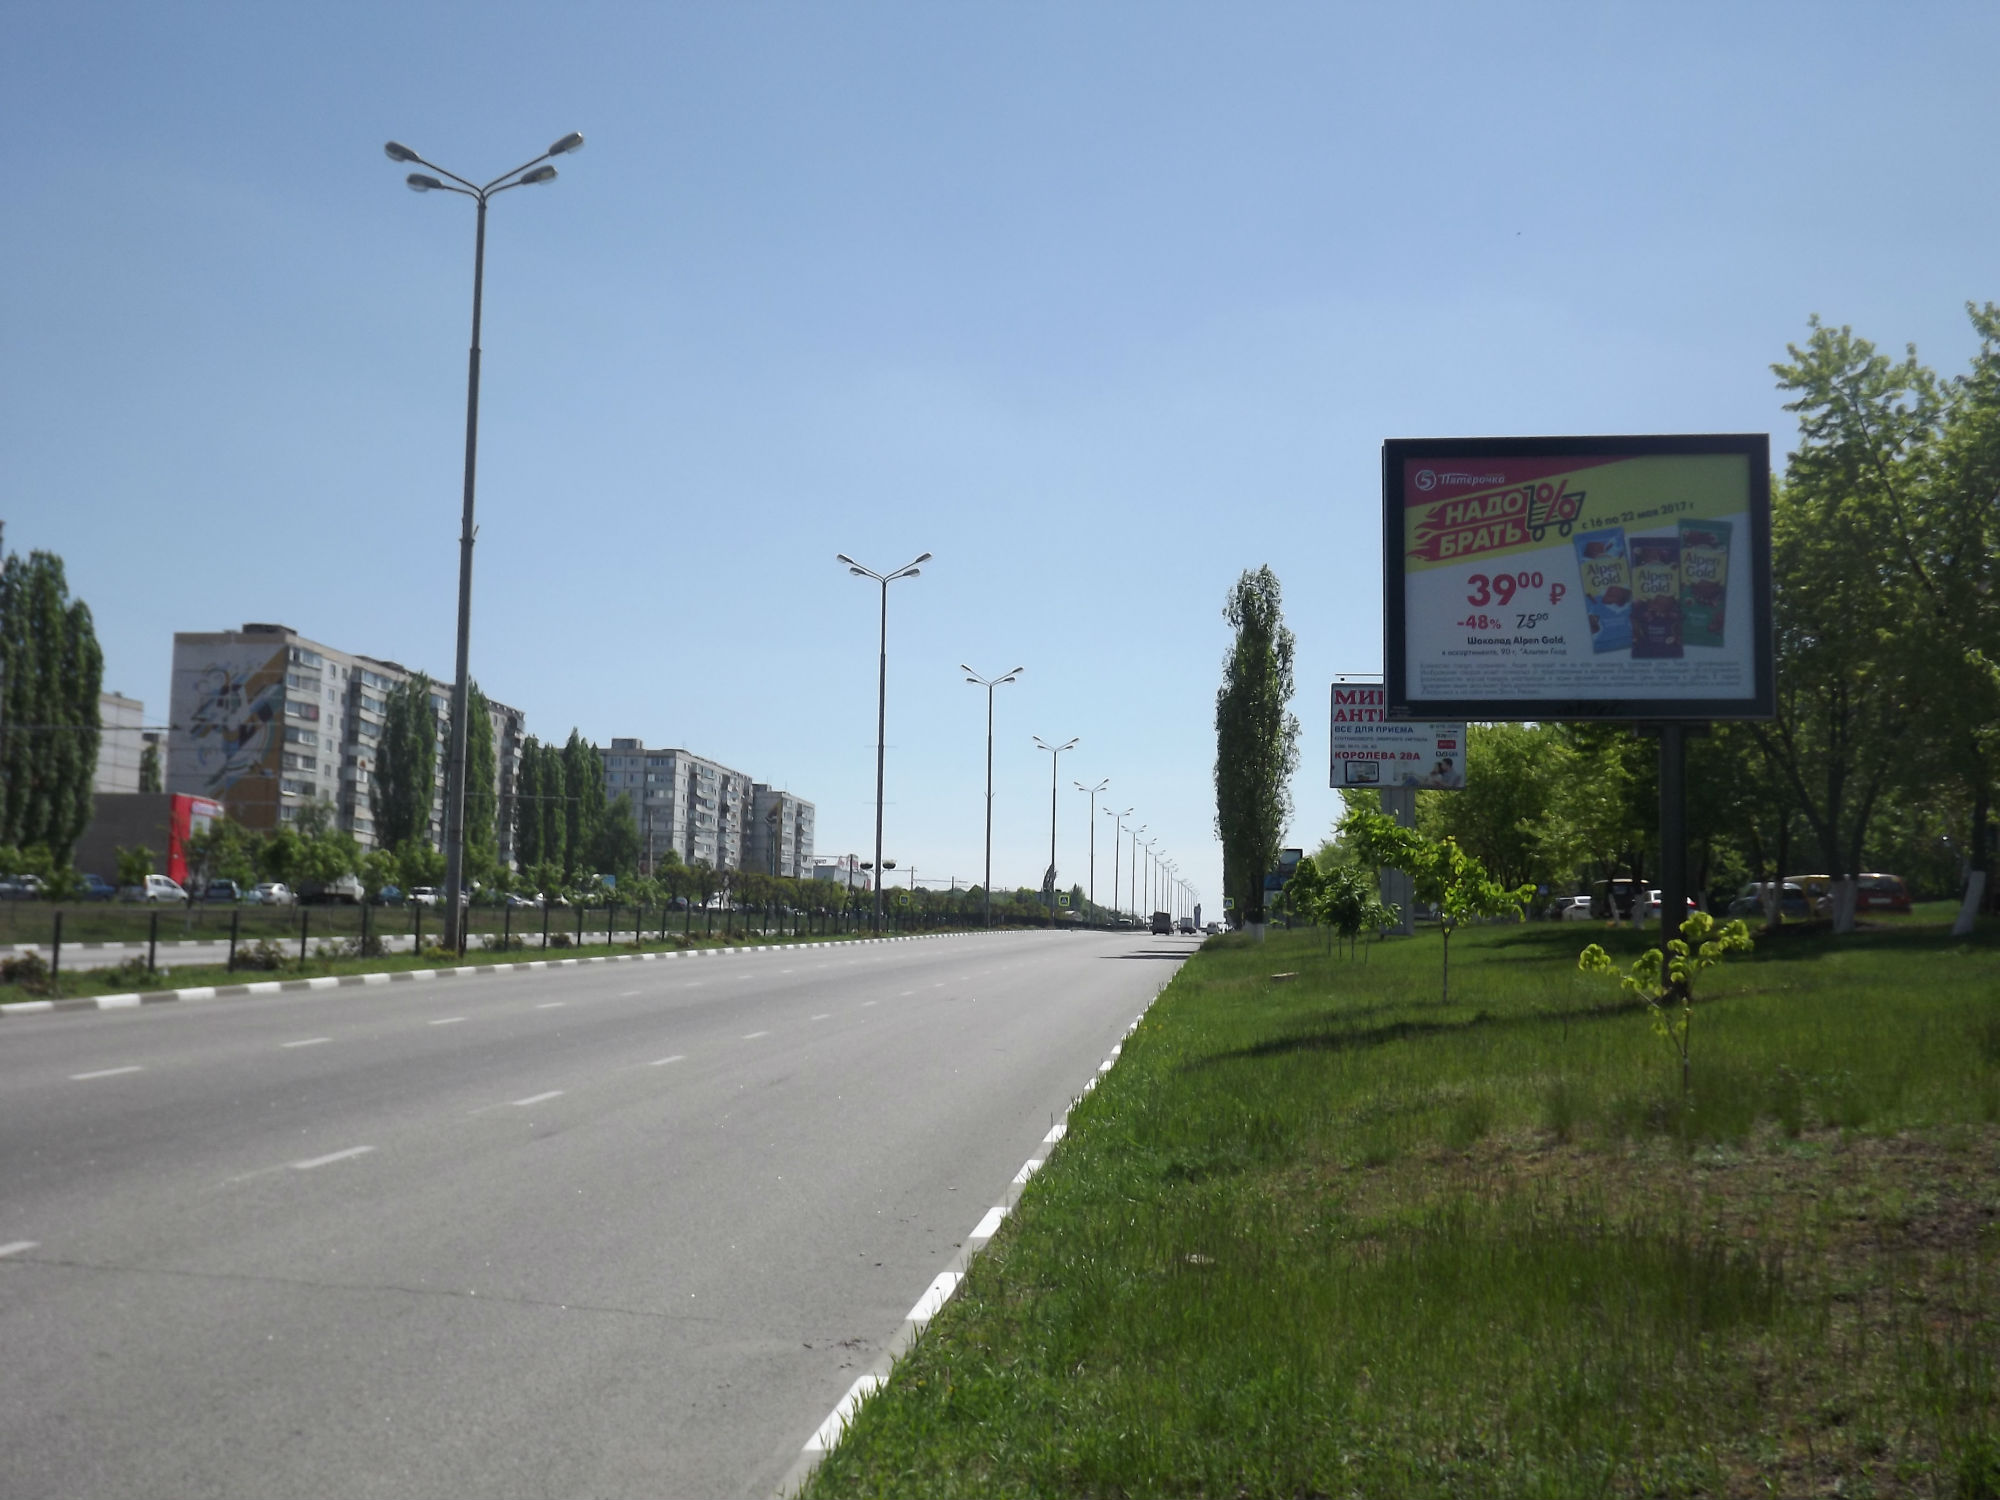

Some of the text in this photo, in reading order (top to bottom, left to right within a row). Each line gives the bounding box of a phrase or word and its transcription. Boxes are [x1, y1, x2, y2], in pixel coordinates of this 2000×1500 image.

[1445, 492, 1524, 526] НАДО
[1590, 518, 1603, 527] 16
[1605, 516, 1619, 525] по
[1621, 511, 1634, 522] 22
[1660, 501, 1687, 515] 2017
[1439, 522, 1522, 557] БРАТЬ
[1683, 552, 1720, 568] Alpen
[1587, 561, 1622, 576] Alpen
[1639, 567, 1673, 583] Alpen
[1686, 563, 1716, 578] Gold
[1591, 574, 1621, 587] Gold
[1641, 579, 1670, 593] Gold
[1467, 636, 1511, 646] Шоколад
[1513, 636, 1539, 646] Alpen
[1355, 726, 1373, 734] ДЛЯ
[1335, 751, 1396, 760] КОРОЛЕВА
